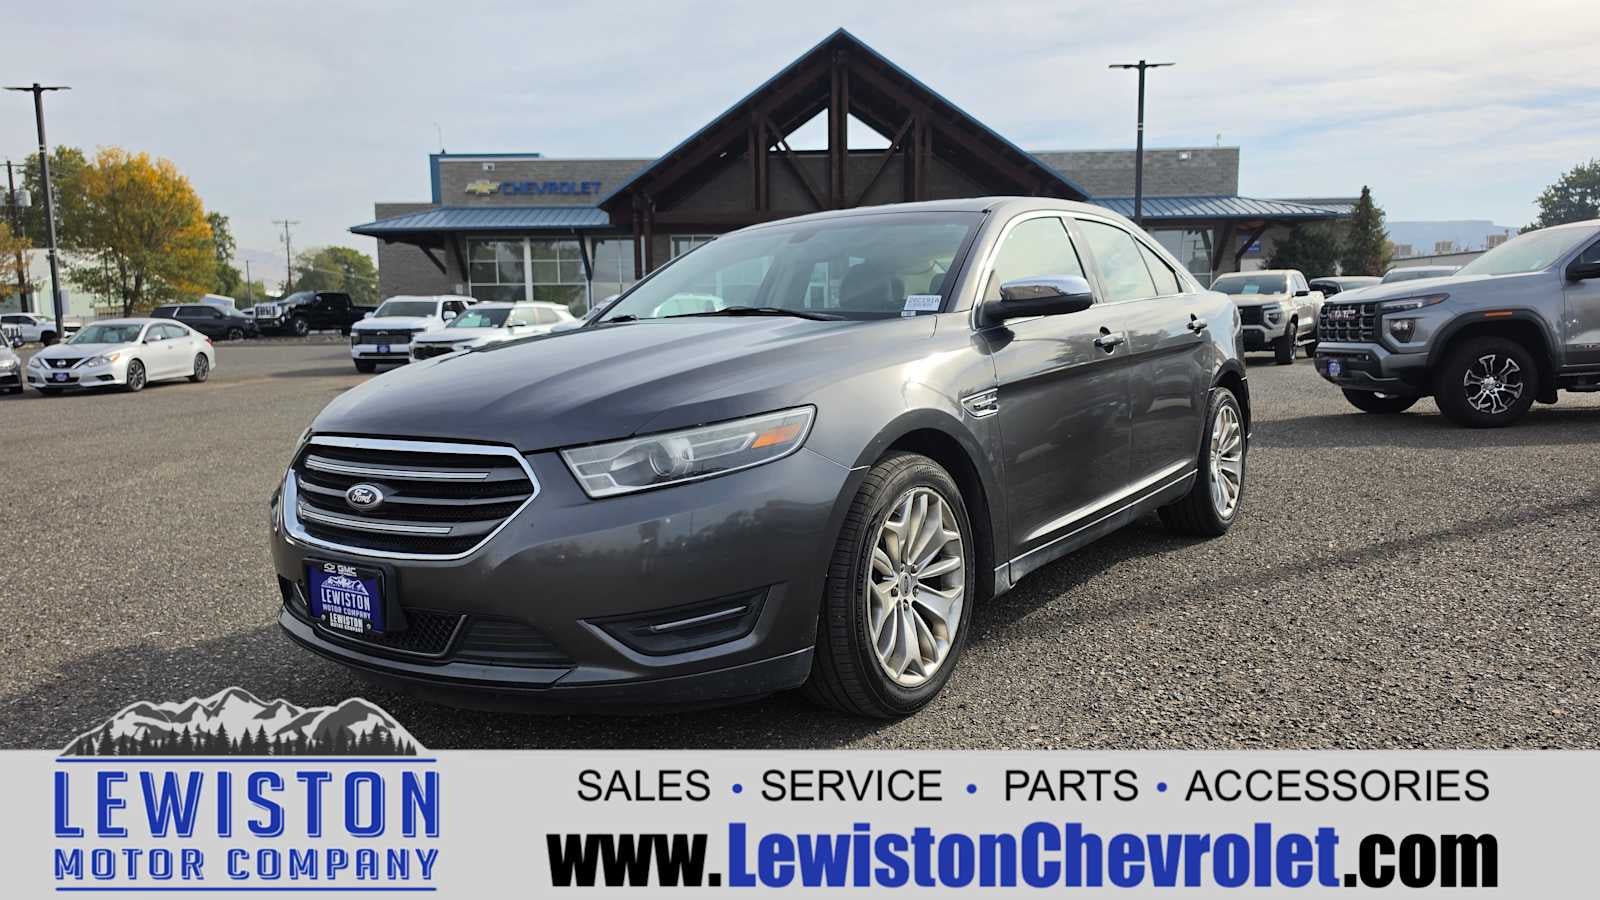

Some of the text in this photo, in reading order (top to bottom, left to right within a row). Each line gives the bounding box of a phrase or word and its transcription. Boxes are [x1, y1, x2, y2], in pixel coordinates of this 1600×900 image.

[501, 180, 601, 196] CHEVROLET
[352, 489, 372, 503] Ford
[337, 565, 357, 575] GMC
[321, 588, 370, 611] LEWISTON
[322, 603, 371, 620] MOTOR COMPANY
[329, 612, 364, 628] LEWISTON
